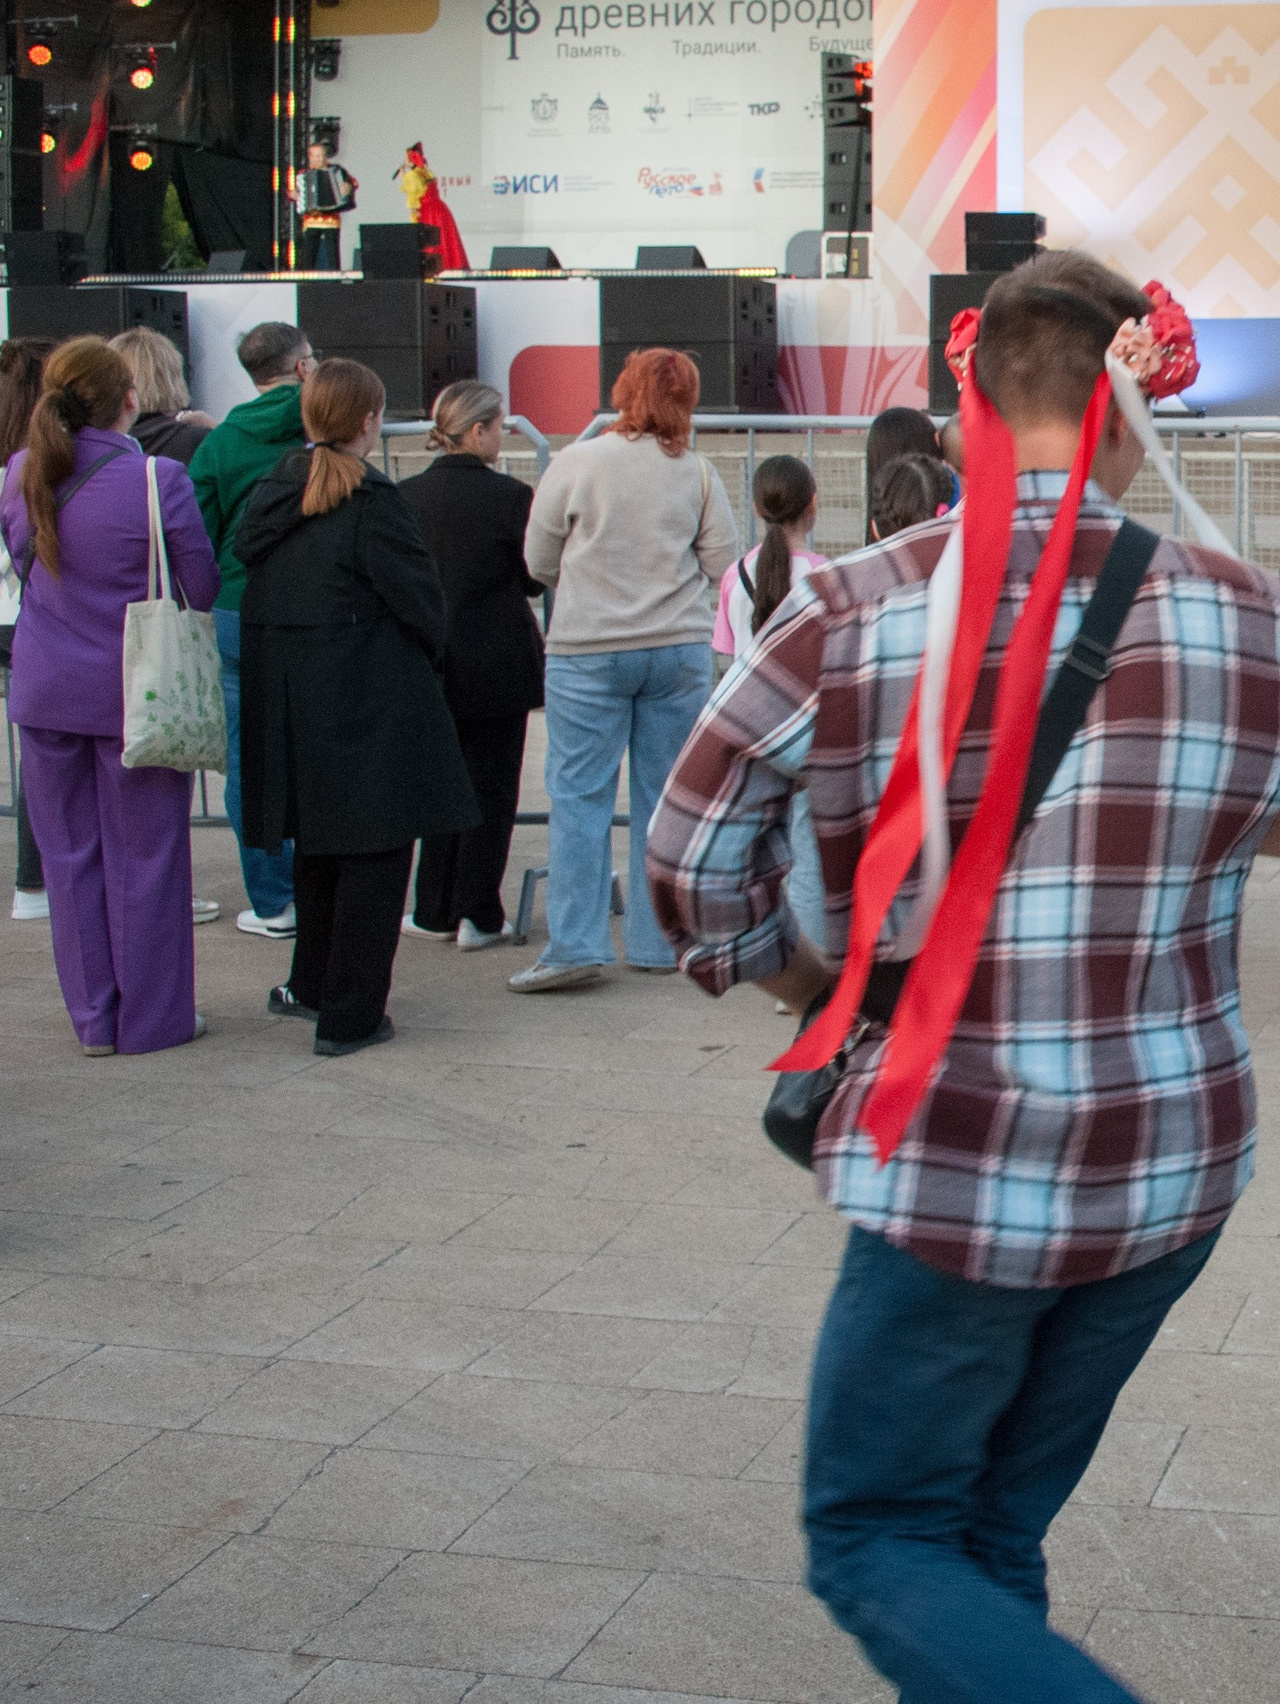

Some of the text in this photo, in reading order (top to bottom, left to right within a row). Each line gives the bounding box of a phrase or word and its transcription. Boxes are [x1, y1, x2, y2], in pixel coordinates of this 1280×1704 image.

[555, 0, 873, 37] древних городо
[557, 43, 625, 58] Память.
[673, 40, 760, 58] Традиции.
